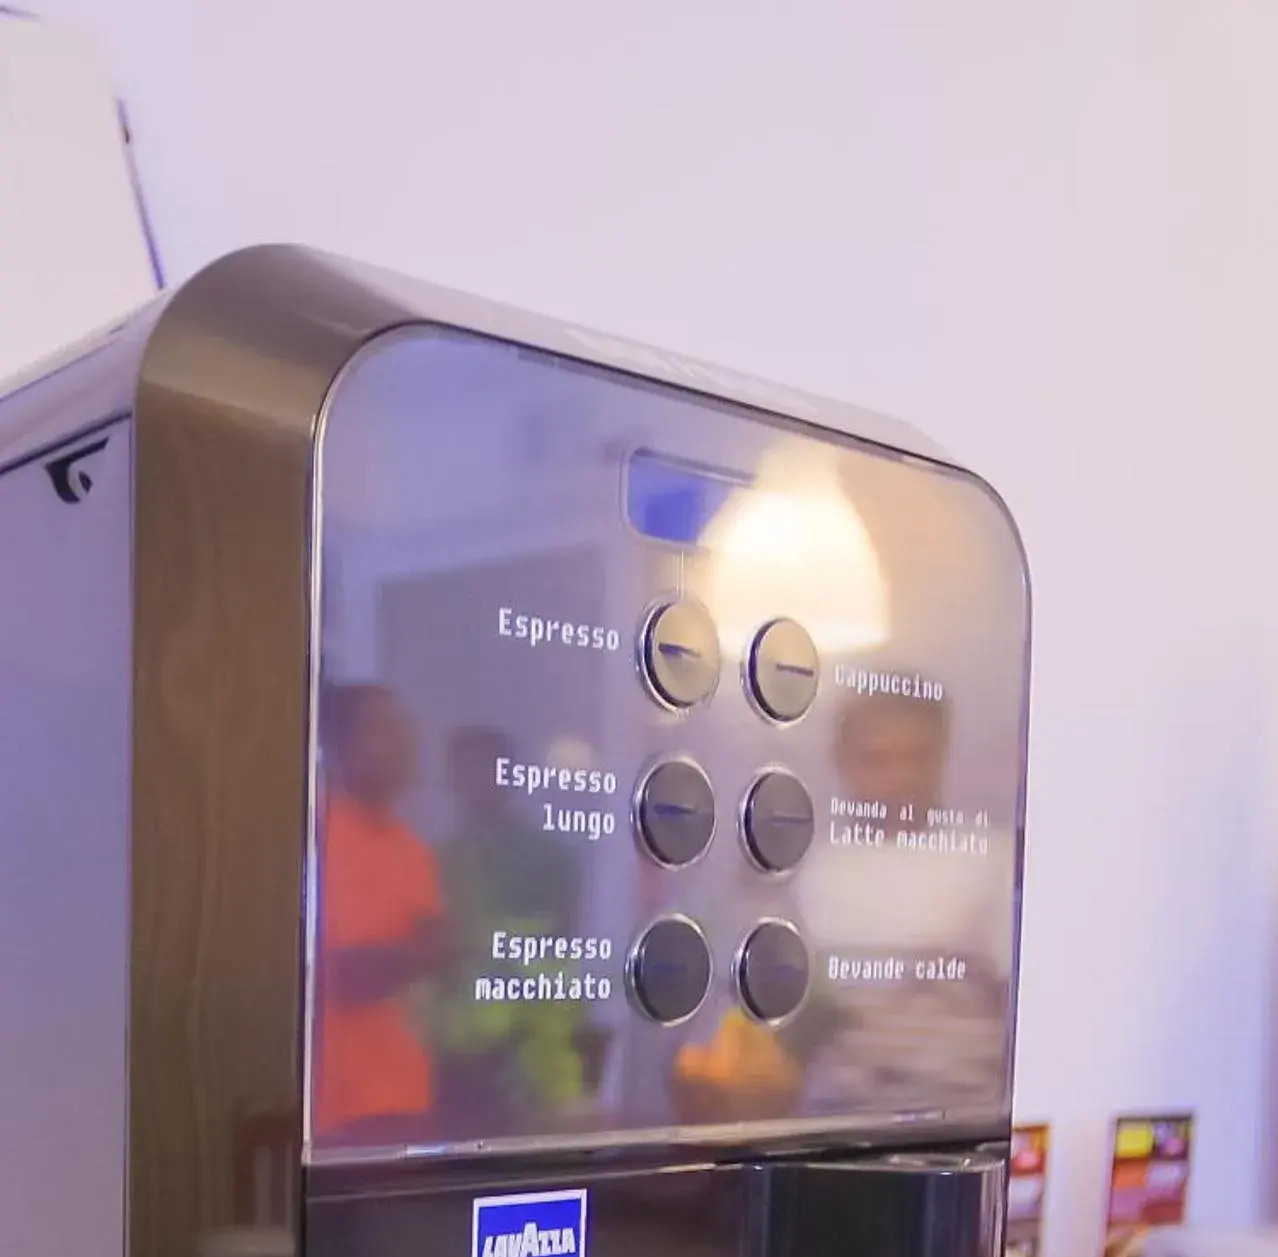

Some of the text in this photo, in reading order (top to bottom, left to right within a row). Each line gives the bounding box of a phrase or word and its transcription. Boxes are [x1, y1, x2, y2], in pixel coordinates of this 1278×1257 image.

[498, 607, 621, 652] Espresso
[833, 663, 945, 701] Cappuccino
[495, 757, 618, 795] Espresso
[542, 803, 616, 840] lungo
[829, 821, 886, 846] Latte
[491, 931, 613, 965] Espresso
[474, 971, 612, 1001] macchiato
[915, 957, 966, 981] calde
